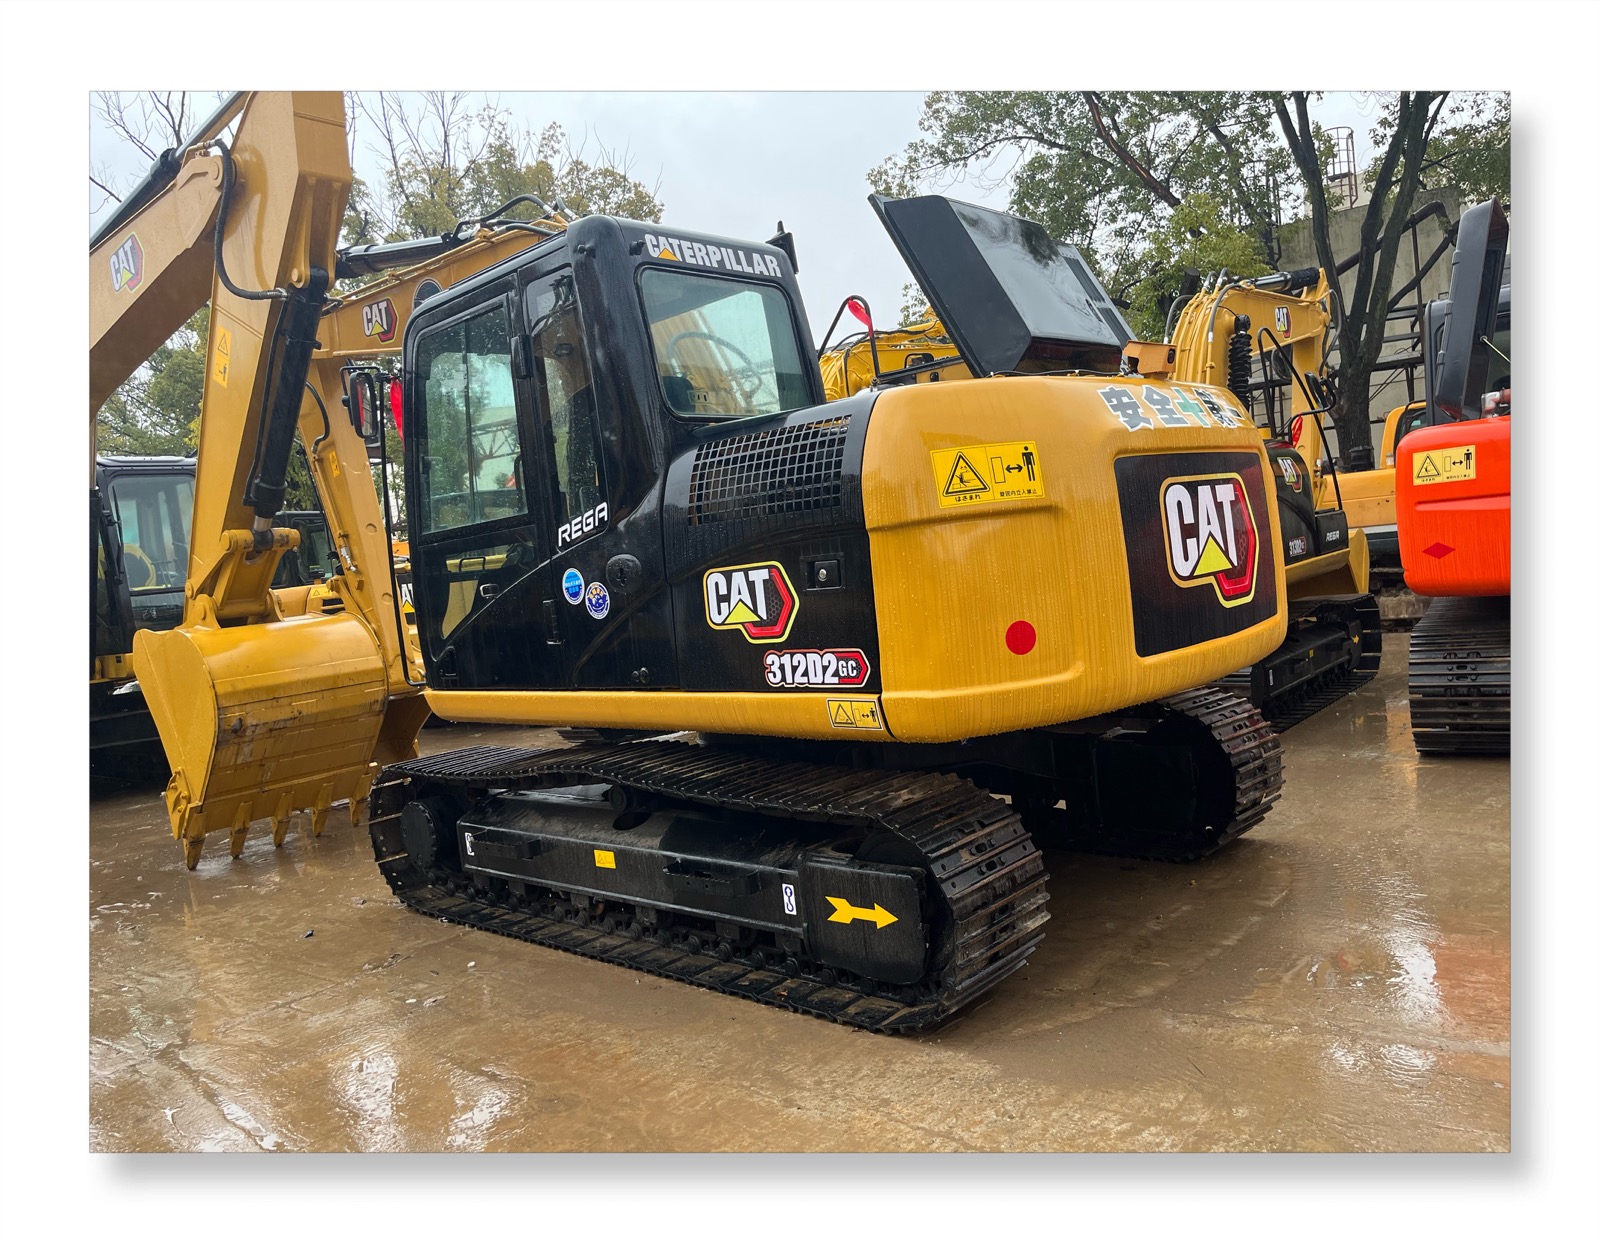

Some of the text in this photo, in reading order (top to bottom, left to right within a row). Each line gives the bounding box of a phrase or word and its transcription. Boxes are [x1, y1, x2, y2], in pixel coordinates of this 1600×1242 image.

[110, 238, 135, 291] CAT
[644, 233, 782, 278] CATERPILLAR
[362, 300, 388, 336] CAT
[1274, 306, 1288, 332] CAT
[1277, 458, 1298, 483] CAT
[557, 501, 608, 547] REGA
[1165, 483, 1238, 577] CAT
[706, 568, 769, 624] CAT
[765, 653, 839, 684] 312D2
